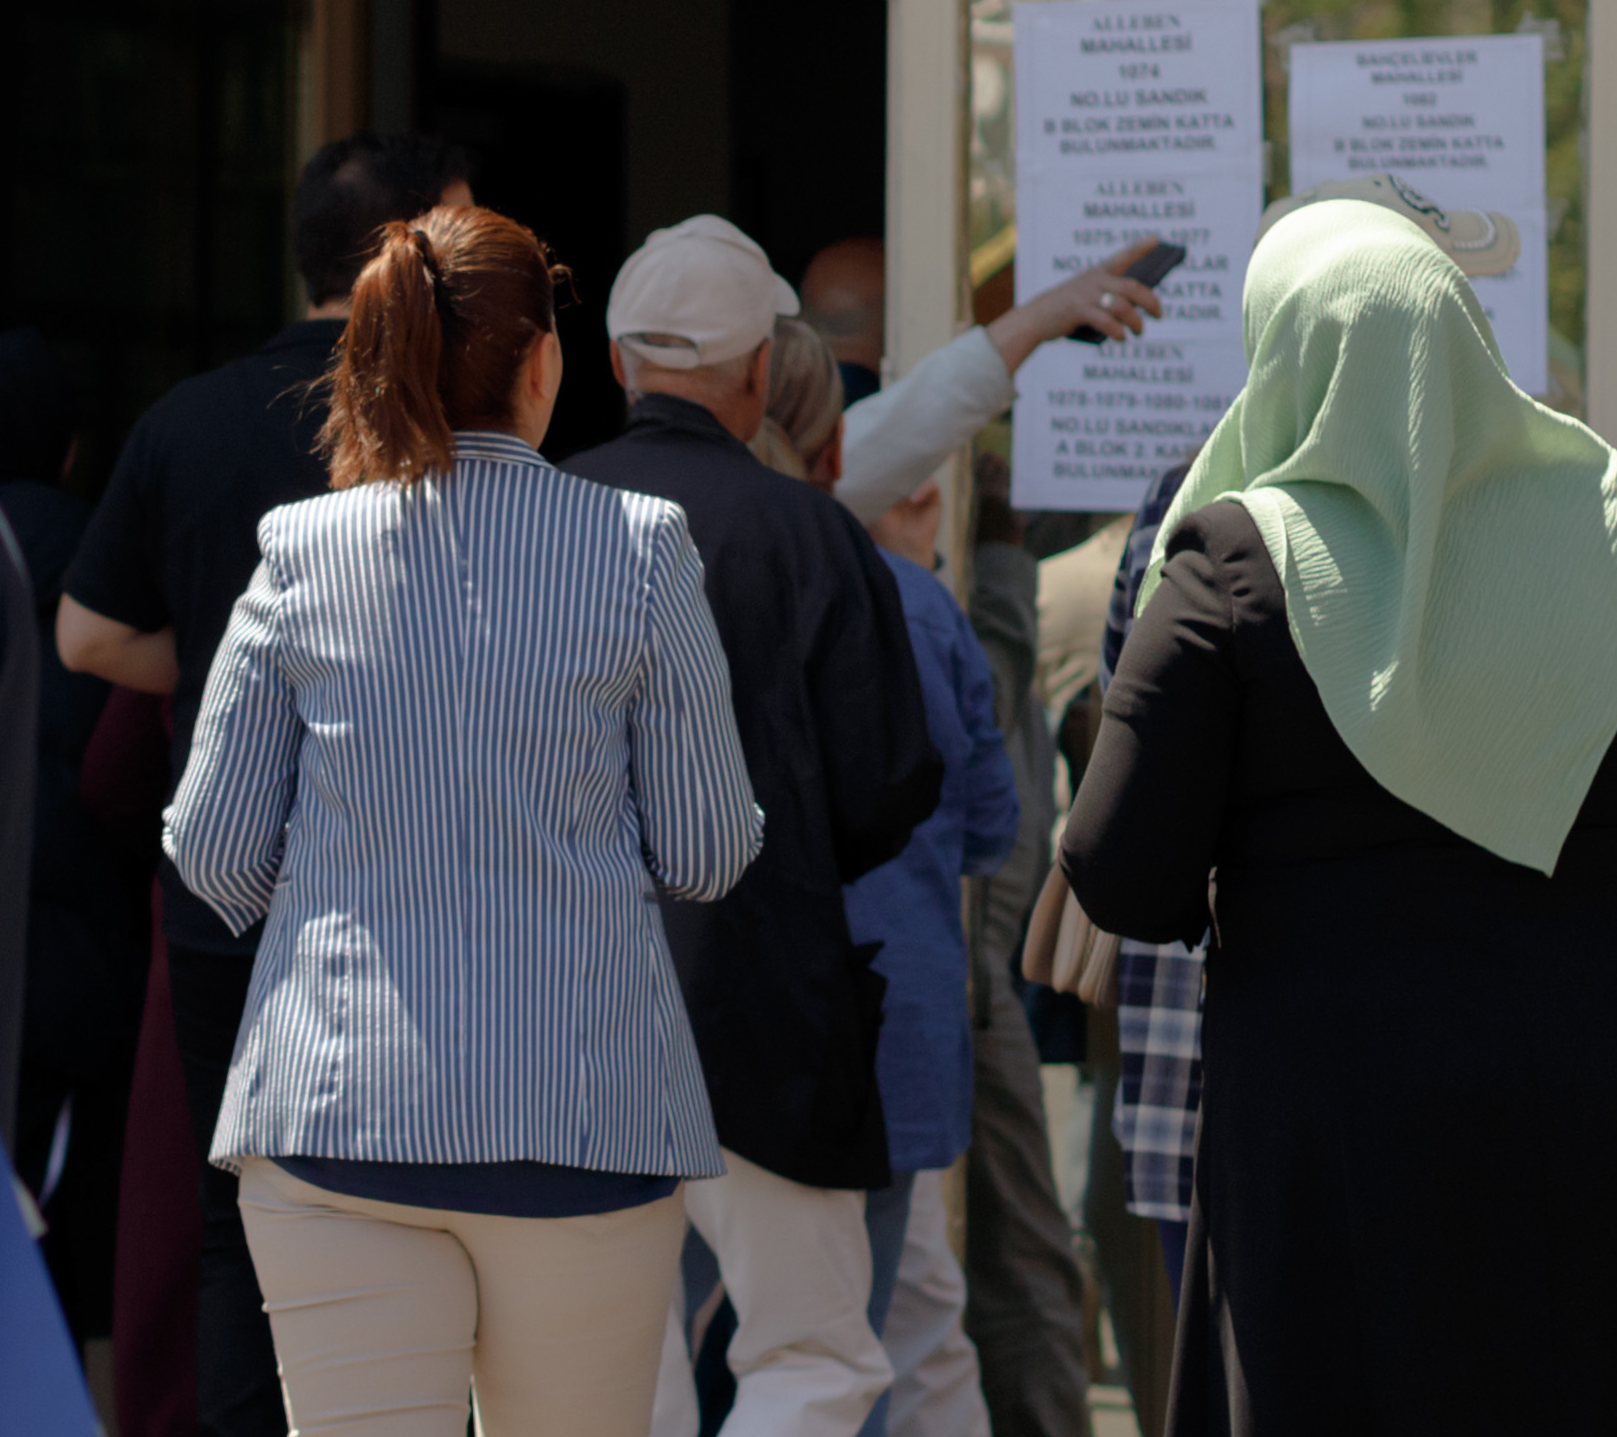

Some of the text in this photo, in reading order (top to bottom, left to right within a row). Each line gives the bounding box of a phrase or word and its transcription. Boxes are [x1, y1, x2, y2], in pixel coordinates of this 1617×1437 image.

[1093, 15, 1181, 32] ALLEBEN
[1080, 33, 1193, 54] MAHALLESİ
[1118, 63, 1162, 80] 1074
[1371, 69, 1464, 84] MAHALLESİ
[1135, 88, 1207, 107] SANDIK
[1043, 113, 1235, 134] B BLOK ZEMİN KATTA
[1350, 137, 1394, 152] BLOK
[1452, 135, 1505, 150] KATTA
[1095, 179, 1185, 195] ALLEBEN
[1083, 200, 1196, 219] MAHALLESİ
[1083, 365, 1194, 383] MAHALLESİ
[1115, 418, 1215, 437] SANDIKLA
[1056, 441, 1069, 455] A
[1075, 440, 1126, 457] BLOK
